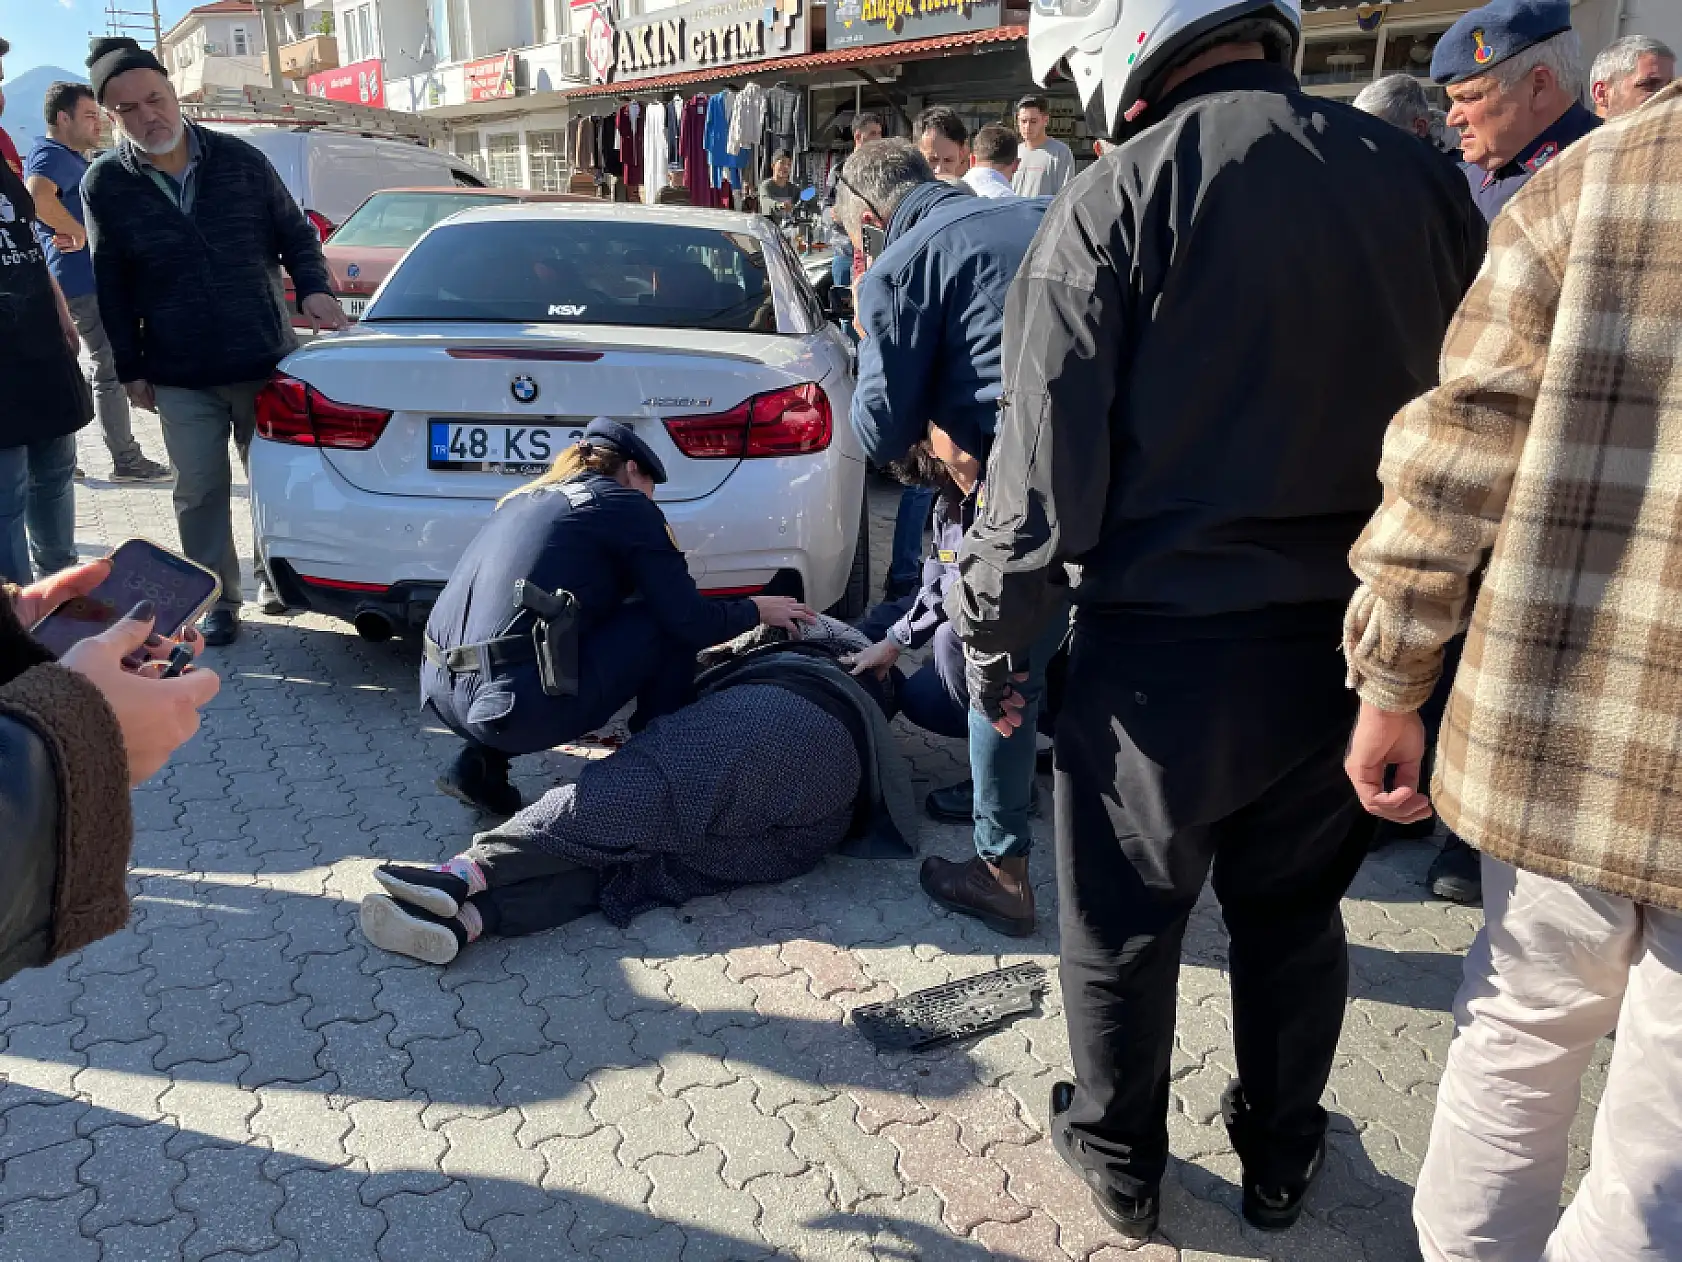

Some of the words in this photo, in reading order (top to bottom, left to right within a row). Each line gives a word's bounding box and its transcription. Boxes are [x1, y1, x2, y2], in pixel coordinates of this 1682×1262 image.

[617, 16, 683, 71] AKIN
[548, 304, 587, 316] KSV
[434, 444, 447, 456] TR
[450, 426, 488, 459] 48
[505, 428, 551, 460] KS
